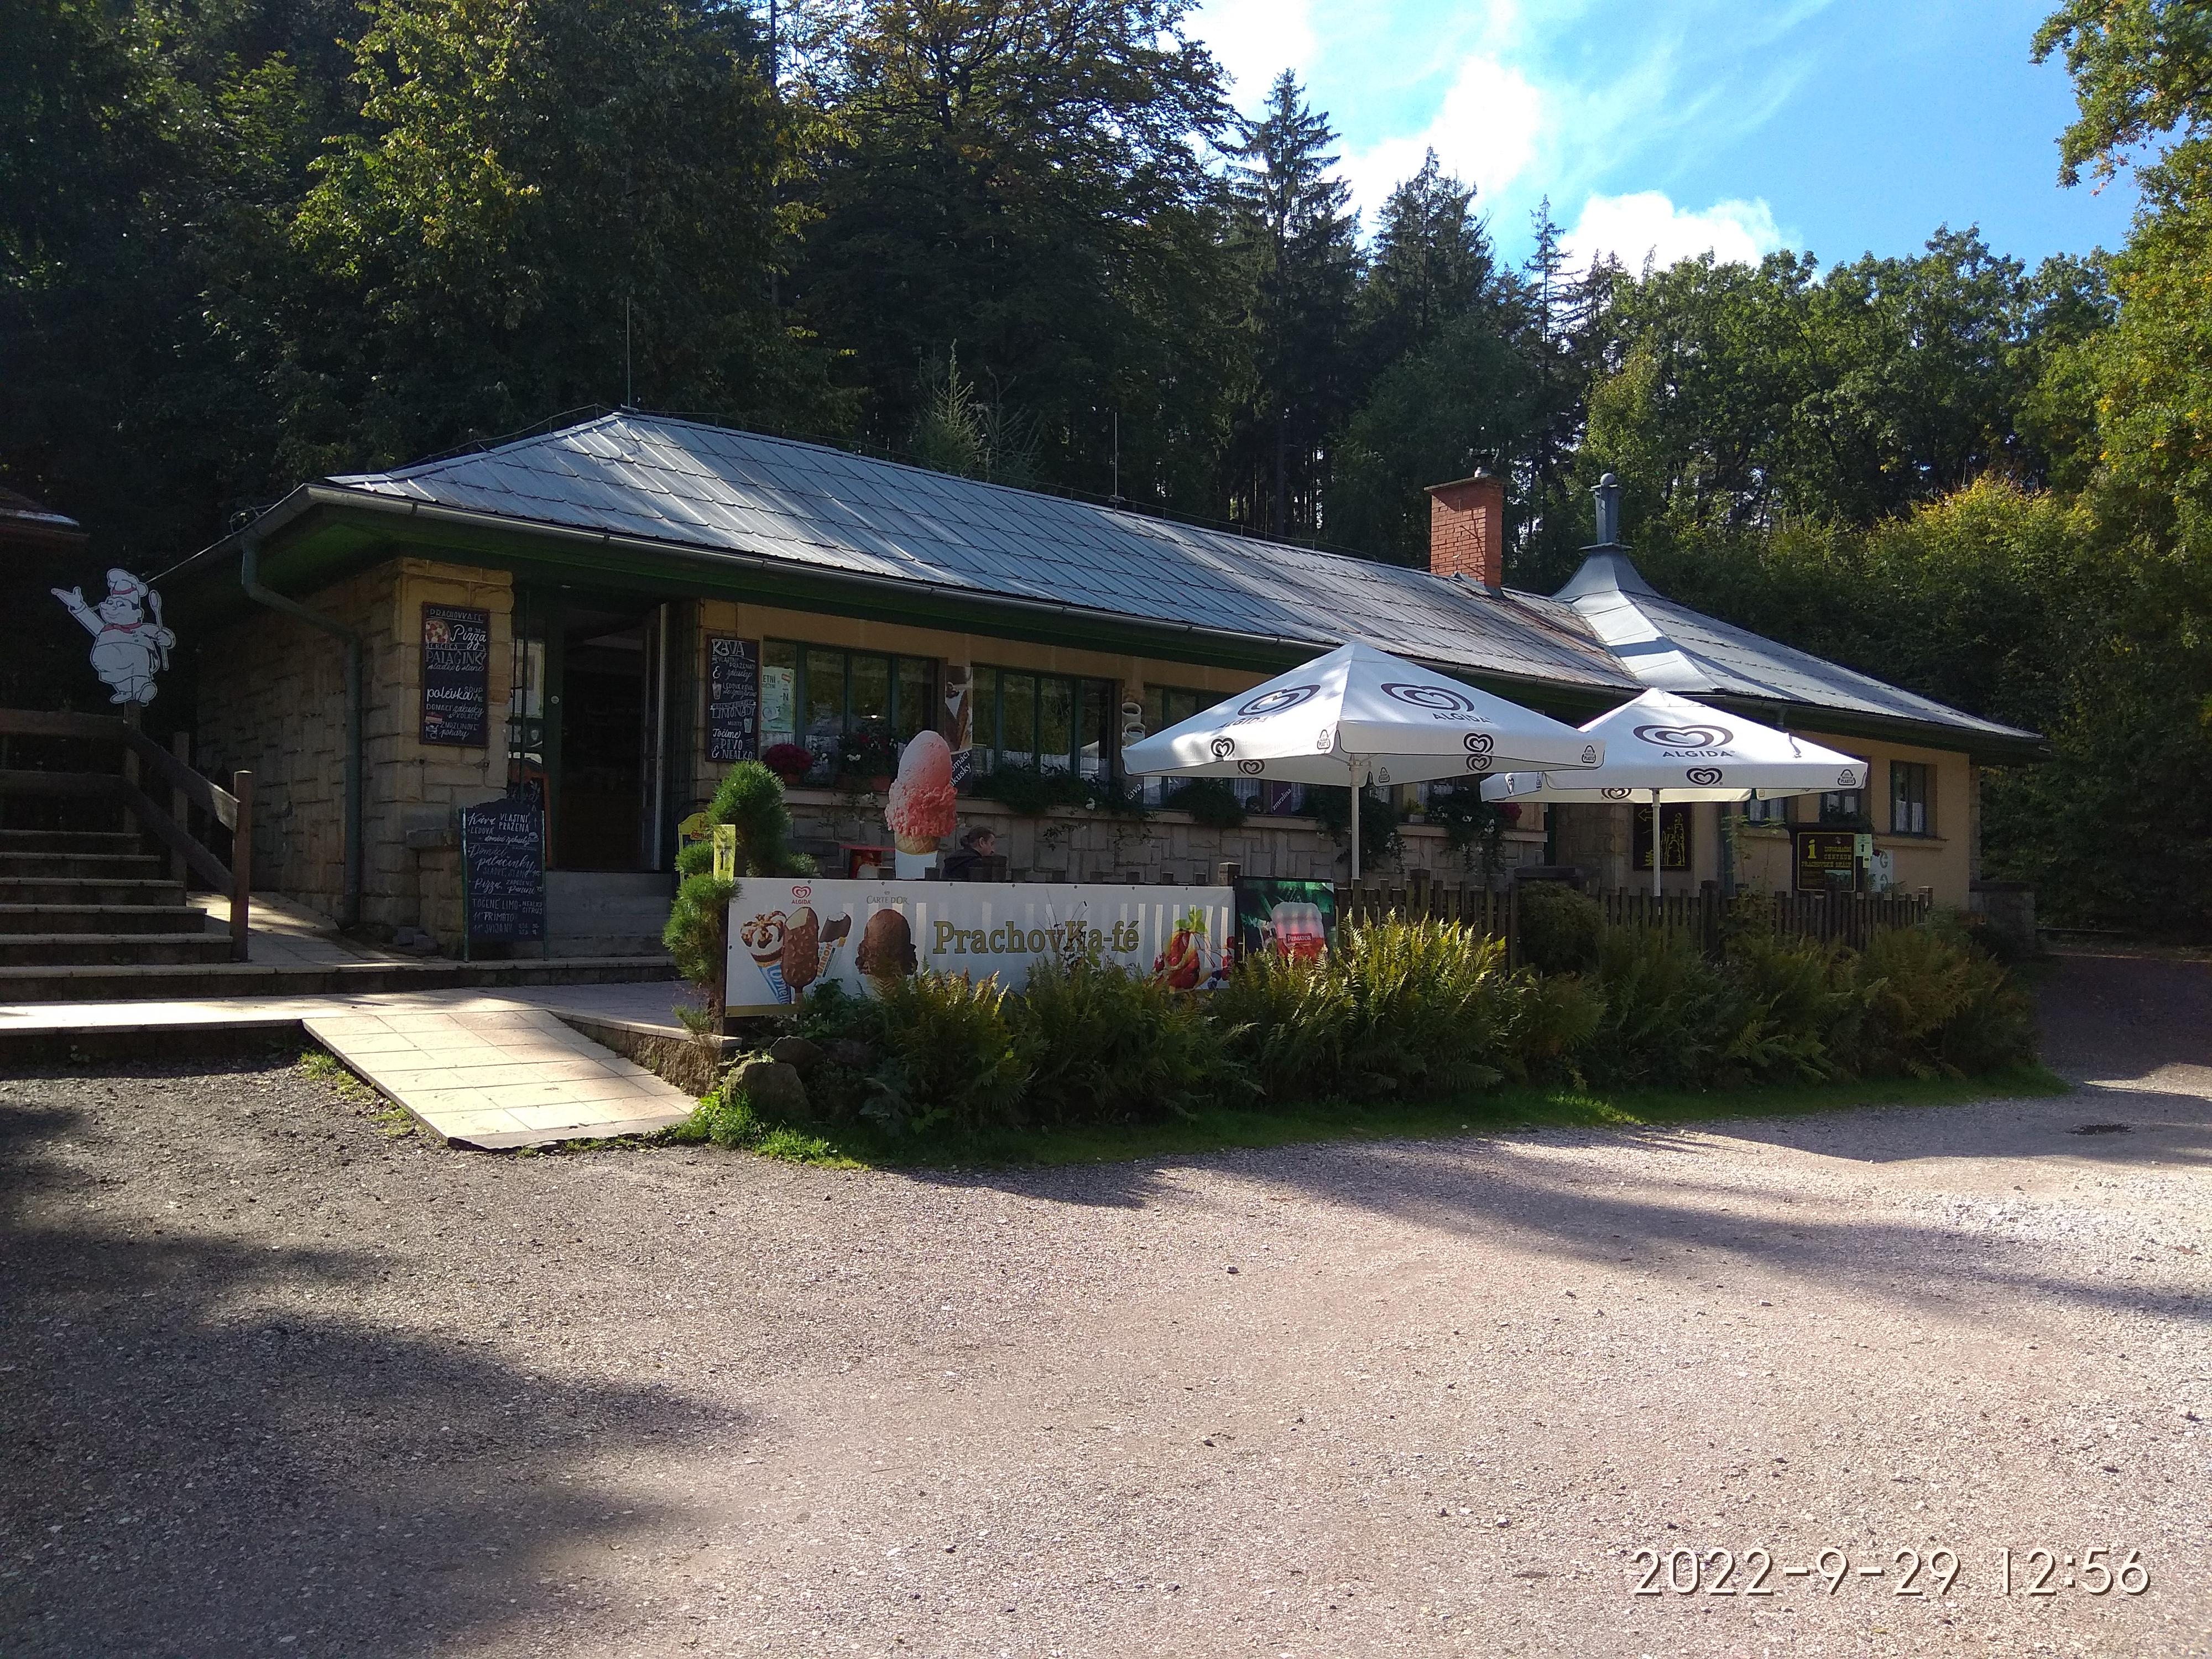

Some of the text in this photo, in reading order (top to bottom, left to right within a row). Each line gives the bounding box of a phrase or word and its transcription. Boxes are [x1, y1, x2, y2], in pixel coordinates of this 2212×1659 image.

[451, 624, 487, 650] Pizza
[1432, 713, 1493, 723] ALGIDA
[1272, 788, 1292, 811] zmrzlina
[867, 895, 889, 905] CARTE
